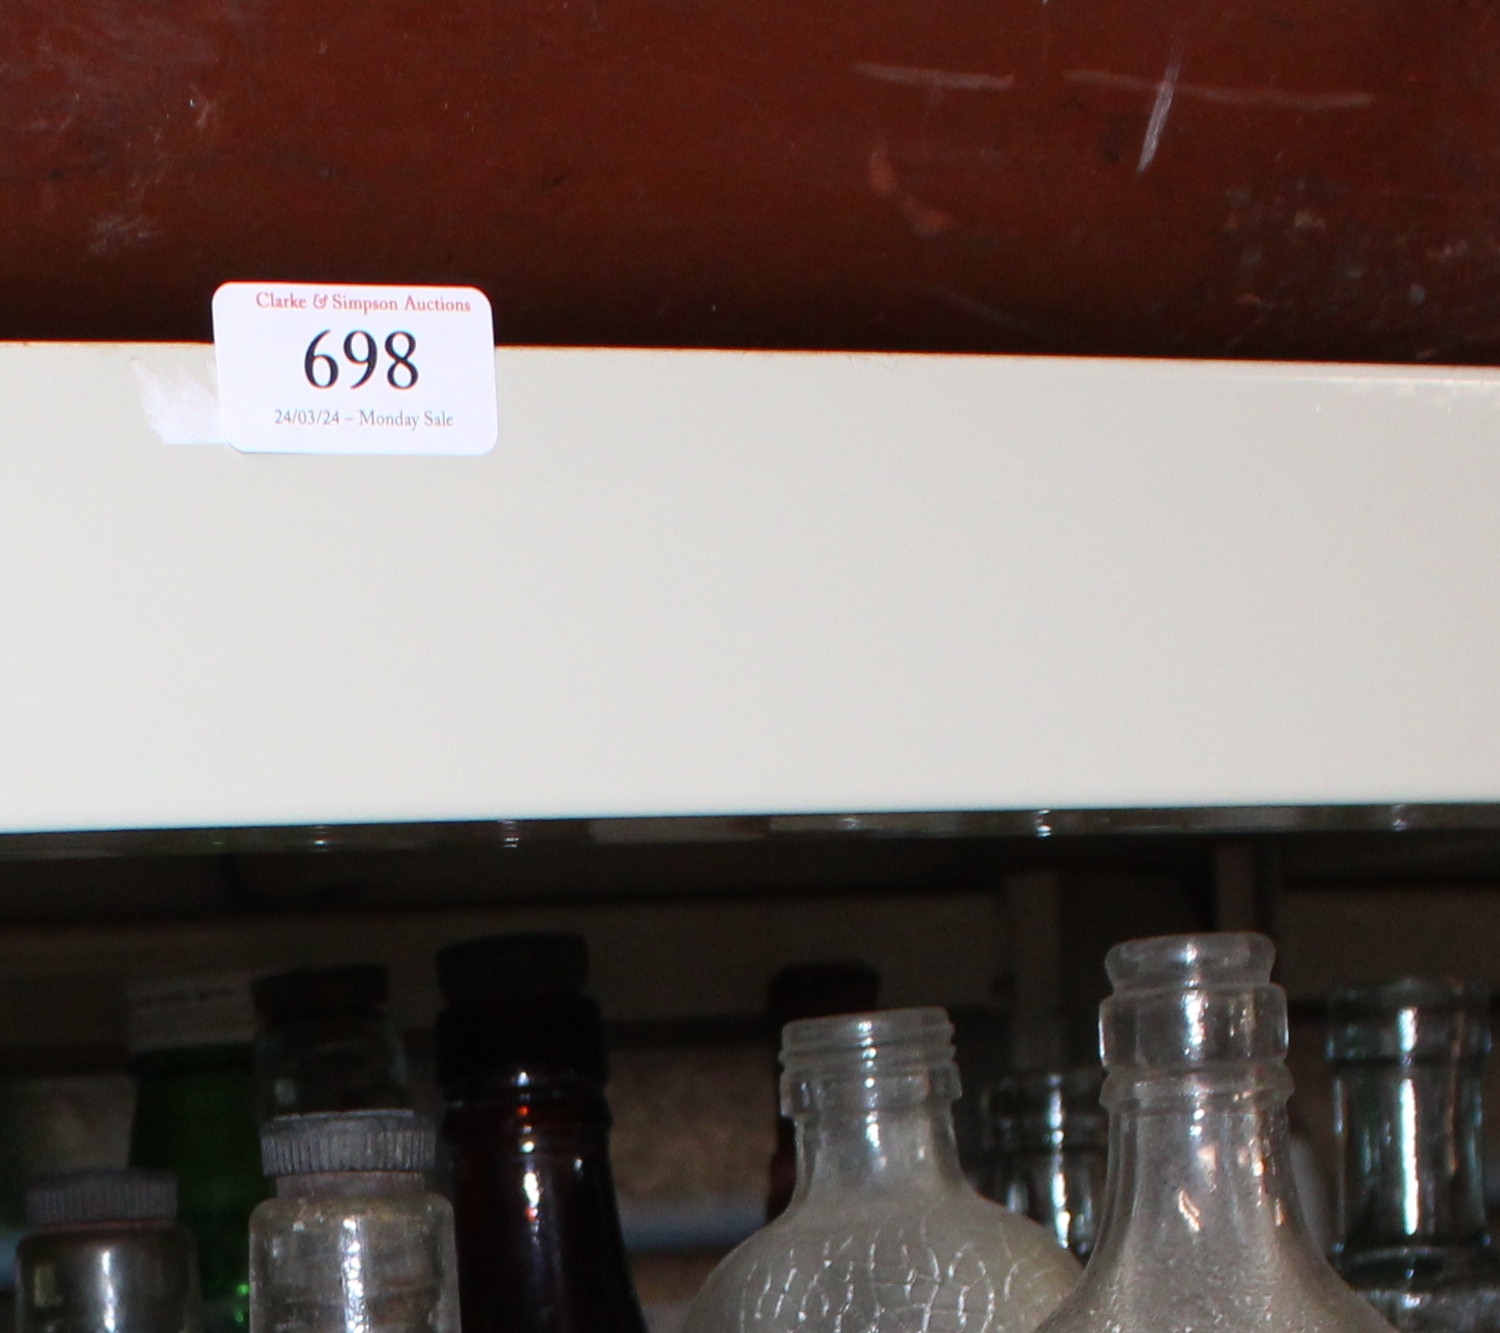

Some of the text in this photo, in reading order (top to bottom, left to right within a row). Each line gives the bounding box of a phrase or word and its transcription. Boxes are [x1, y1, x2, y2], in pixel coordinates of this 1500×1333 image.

[255, 292, 472, 316] Clarke & Simpson Auctions
[304, 328, 420, 391] 698
[274, 408, 341, 427] 24/03/24
[358, 409, 420, 432] Monday
[424, 410, 455, 428] Sale
